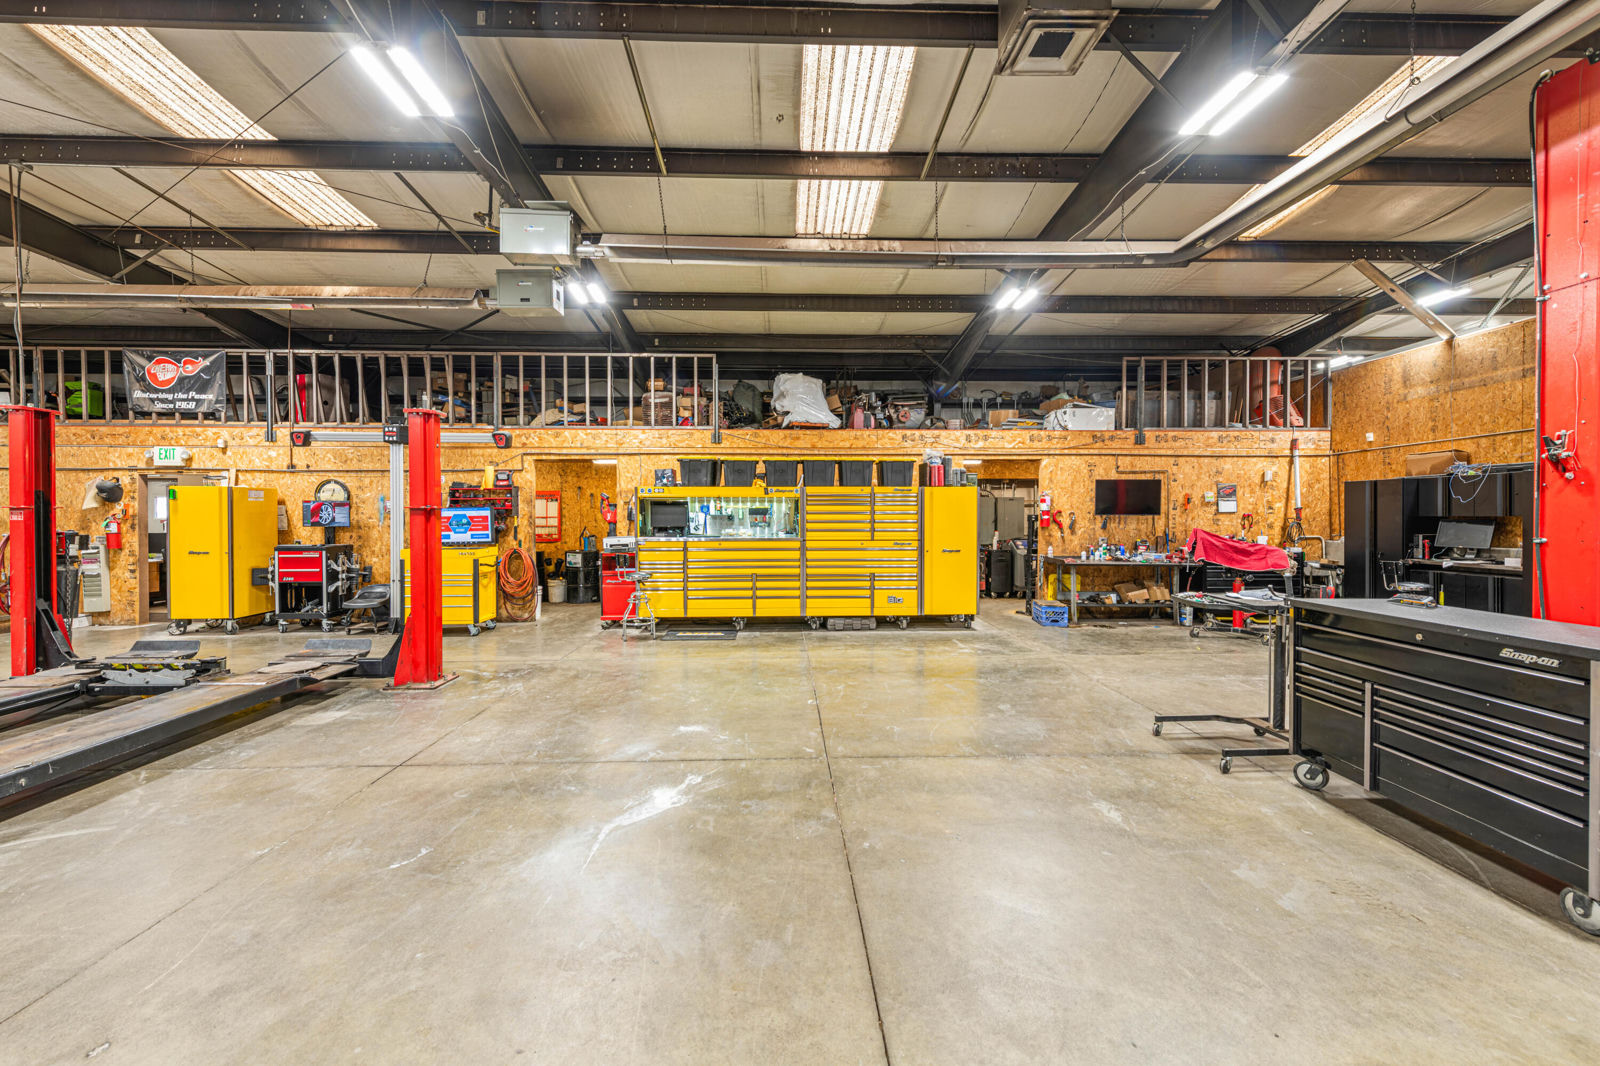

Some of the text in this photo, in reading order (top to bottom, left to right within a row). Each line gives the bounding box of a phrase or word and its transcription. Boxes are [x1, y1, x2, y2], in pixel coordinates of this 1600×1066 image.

[133, 390, 174, 400] Disturbing
[188, 391, 213, 399] Peace
[158, 447, 177, 461] EXIT
[1499, 648, 1560, 667] Snap-on
